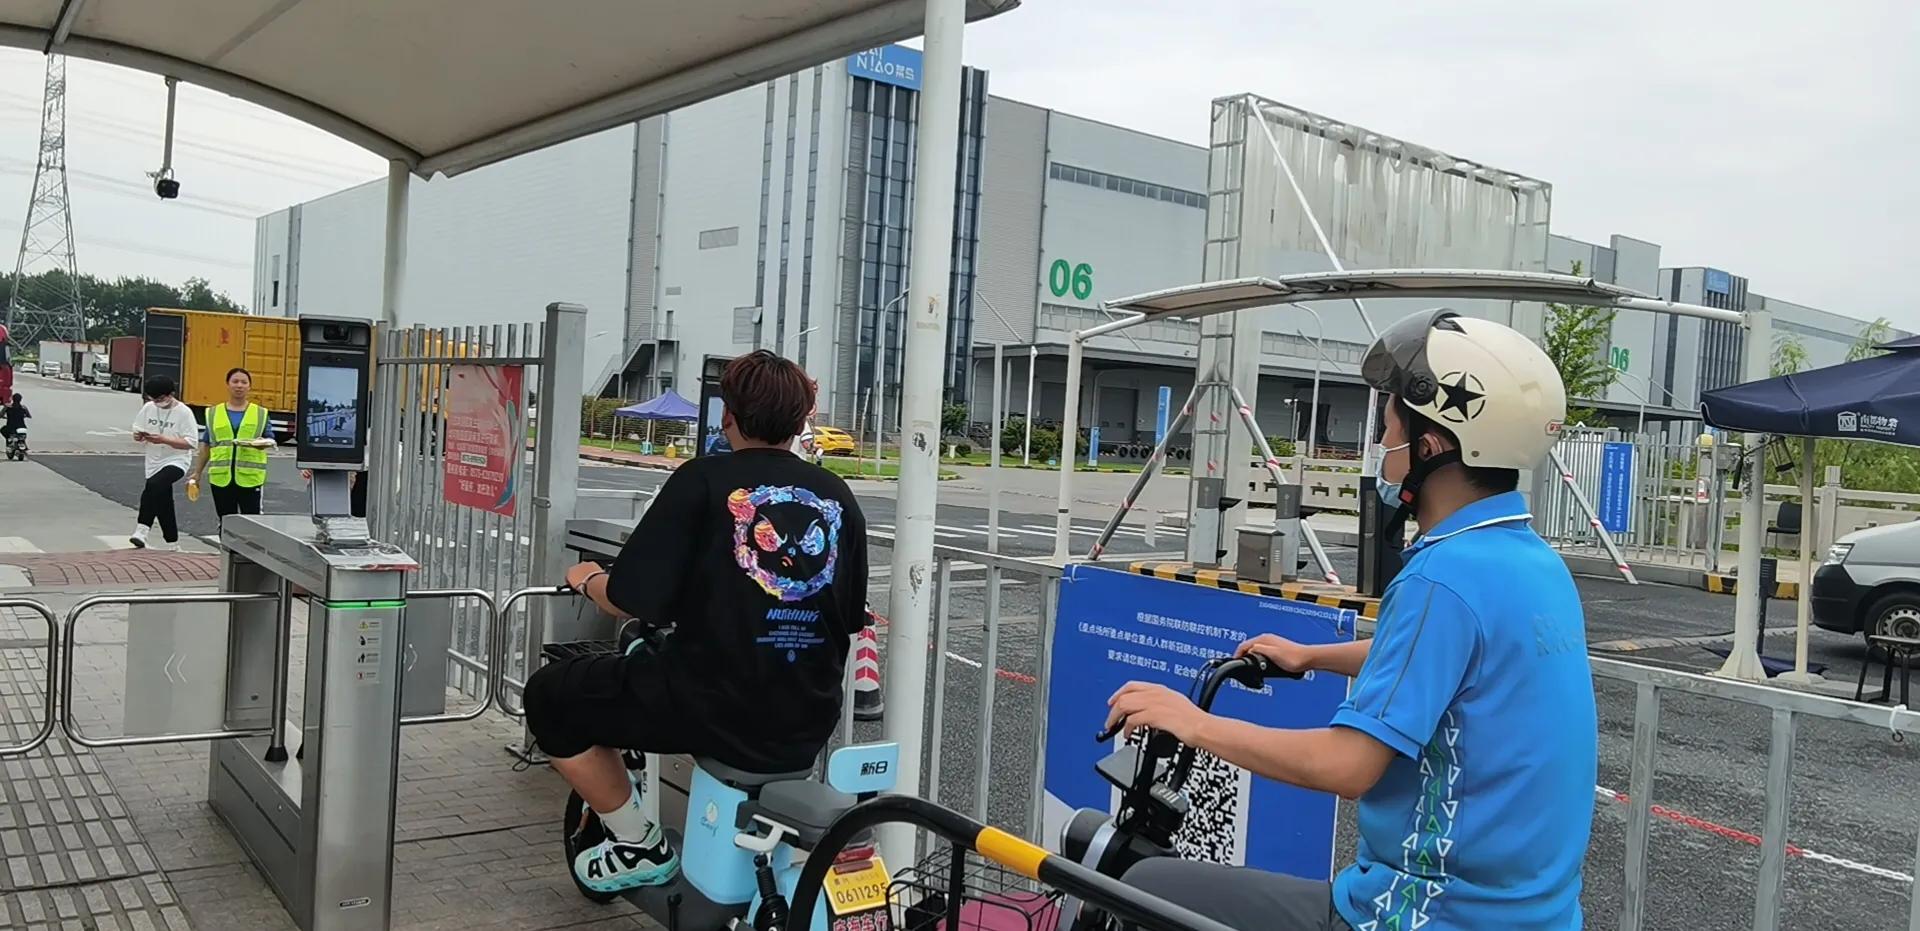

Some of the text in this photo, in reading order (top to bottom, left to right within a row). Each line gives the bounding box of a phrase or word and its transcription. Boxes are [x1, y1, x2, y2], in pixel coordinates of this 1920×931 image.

[1049, 258, 1094, 301] 06
[1611, 346, 1630, 372] 06
[860, 760, 889, 777] 新日
[836, 881, 887, 904] 0611295
